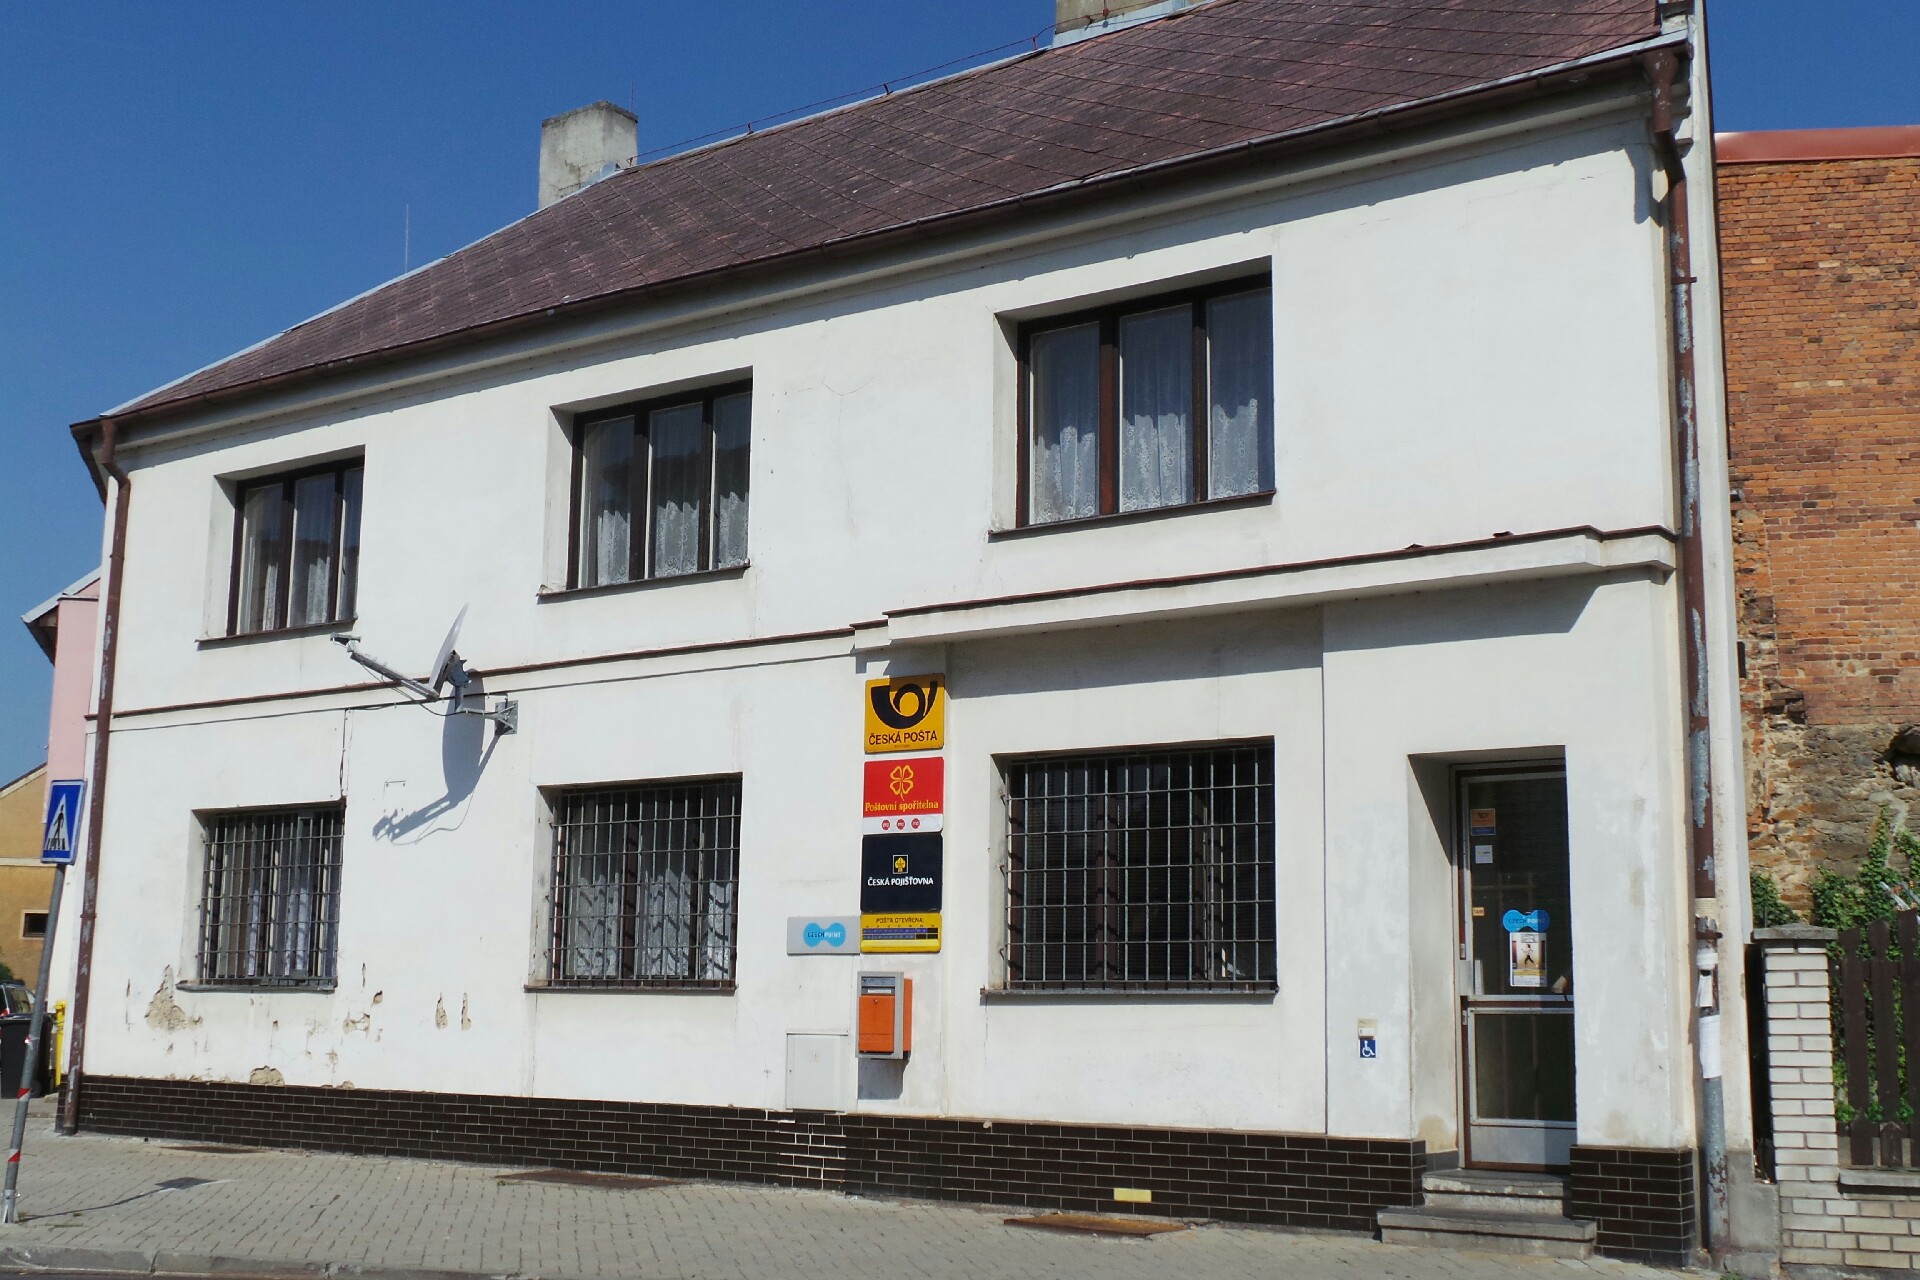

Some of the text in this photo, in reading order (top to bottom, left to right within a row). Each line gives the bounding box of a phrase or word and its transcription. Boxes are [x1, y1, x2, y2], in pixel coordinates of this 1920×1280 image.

[869, 730, 938, 745] ČESKÁ POŠTA
[865, 799, 939, 812] Poštovní spořitelna
[867, 876, 934, 886] ČESKÁ POJIŠŤOVNA
